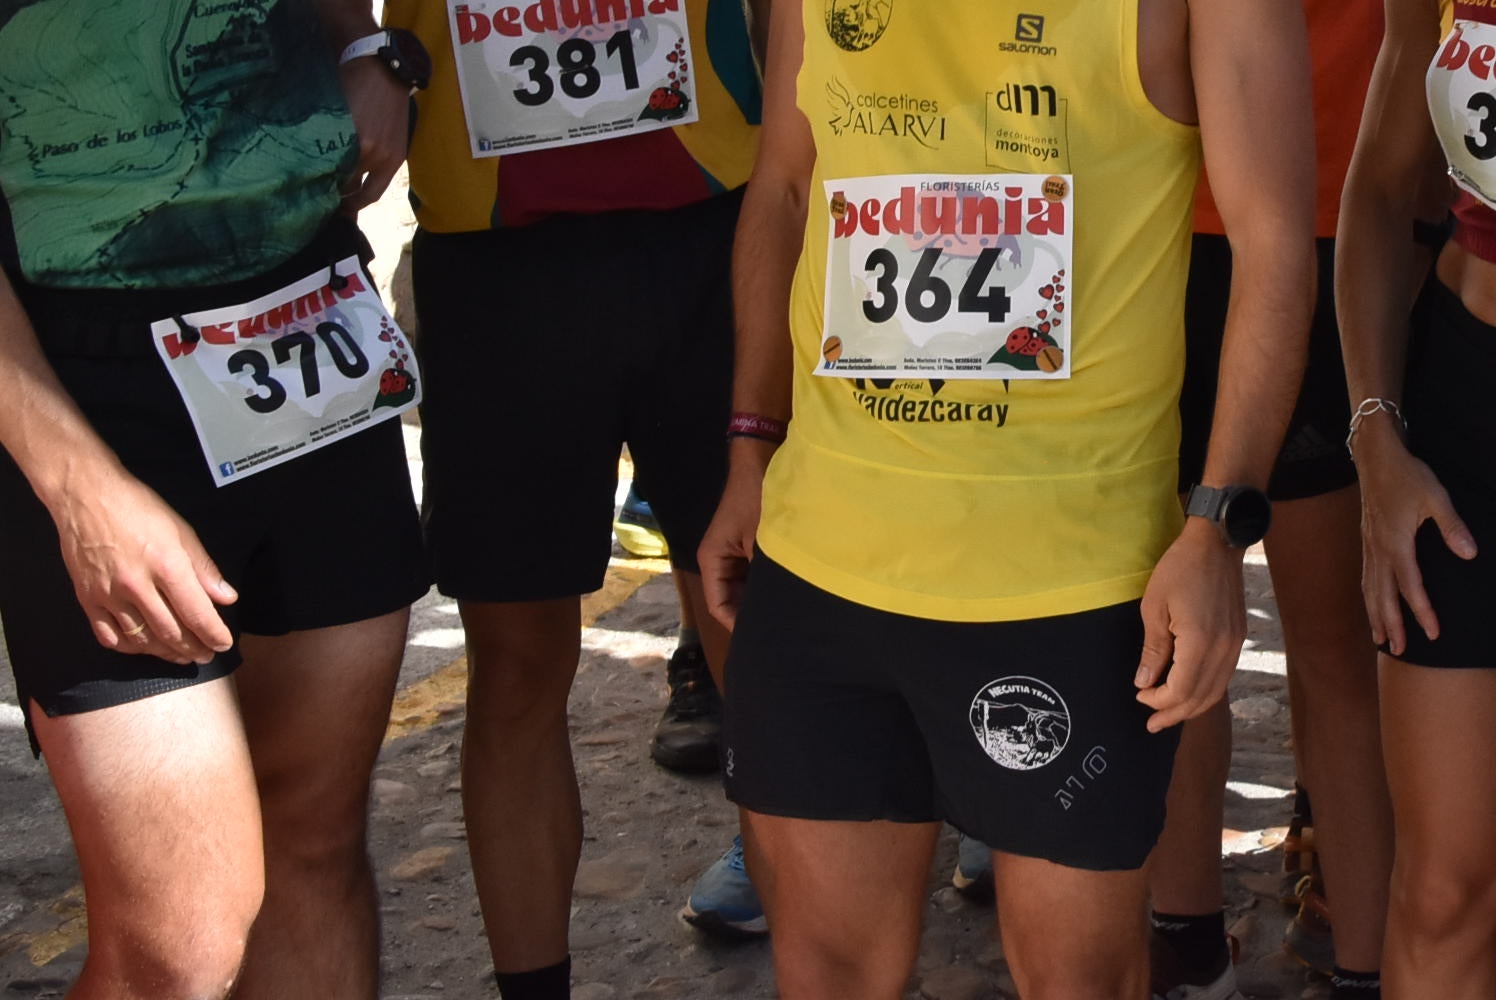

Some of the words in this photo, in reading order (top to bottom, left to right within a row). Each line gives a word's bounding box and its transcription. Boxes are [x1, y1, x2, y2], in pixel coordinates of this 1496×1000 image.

[509, 29, 640, 107] 381
[857, 92, 938, 113] calcetines
[87, 134, 109, 150] de
[995, 139, 1059, 161] montoya
[920, 179, 1000, 193] FLORISTERÍAS
[832, 186, 1066, 239] bedunia
[862, 247, 1011, 324] 364
[227, 321, 369, 414] 370
[988, 684, 1030, 698] NECUTIA
[1031, 688, 1056, 705] TEAM
